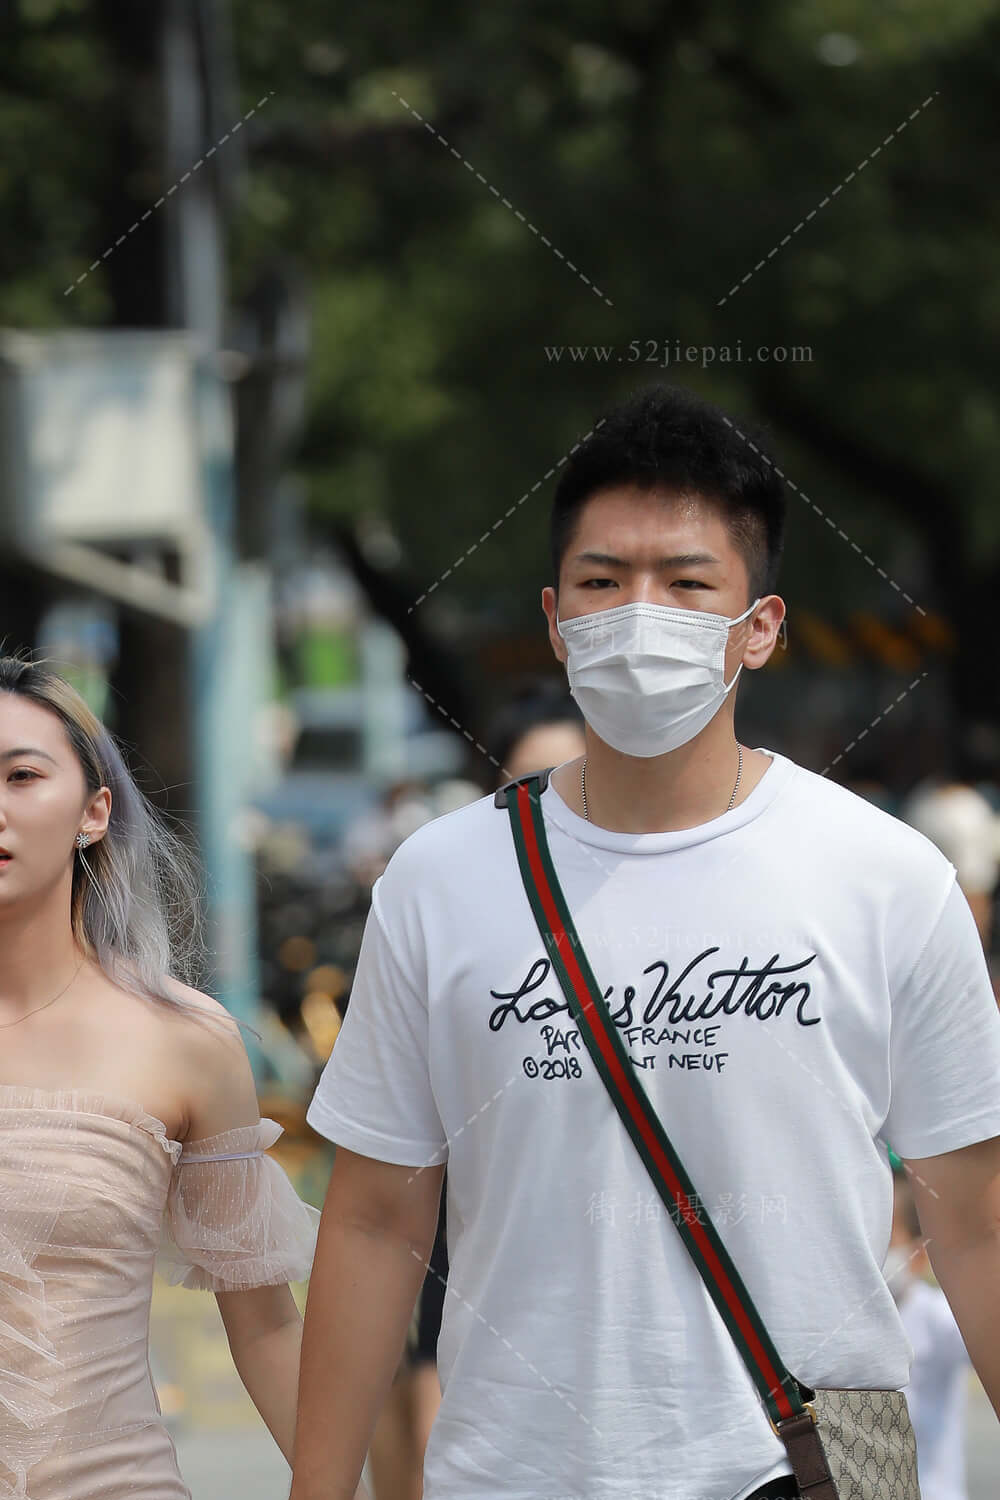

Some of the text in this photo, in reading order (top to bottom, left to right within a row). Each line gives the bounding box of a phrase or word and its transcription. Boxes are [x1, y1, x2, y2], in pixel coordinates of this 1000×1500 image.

[489, 946, 822, 1032] Lois Vuitton
[540, 1025, 721, 1056] PAR FRANCE
[668, 1053, 728, 1073] NEUF
